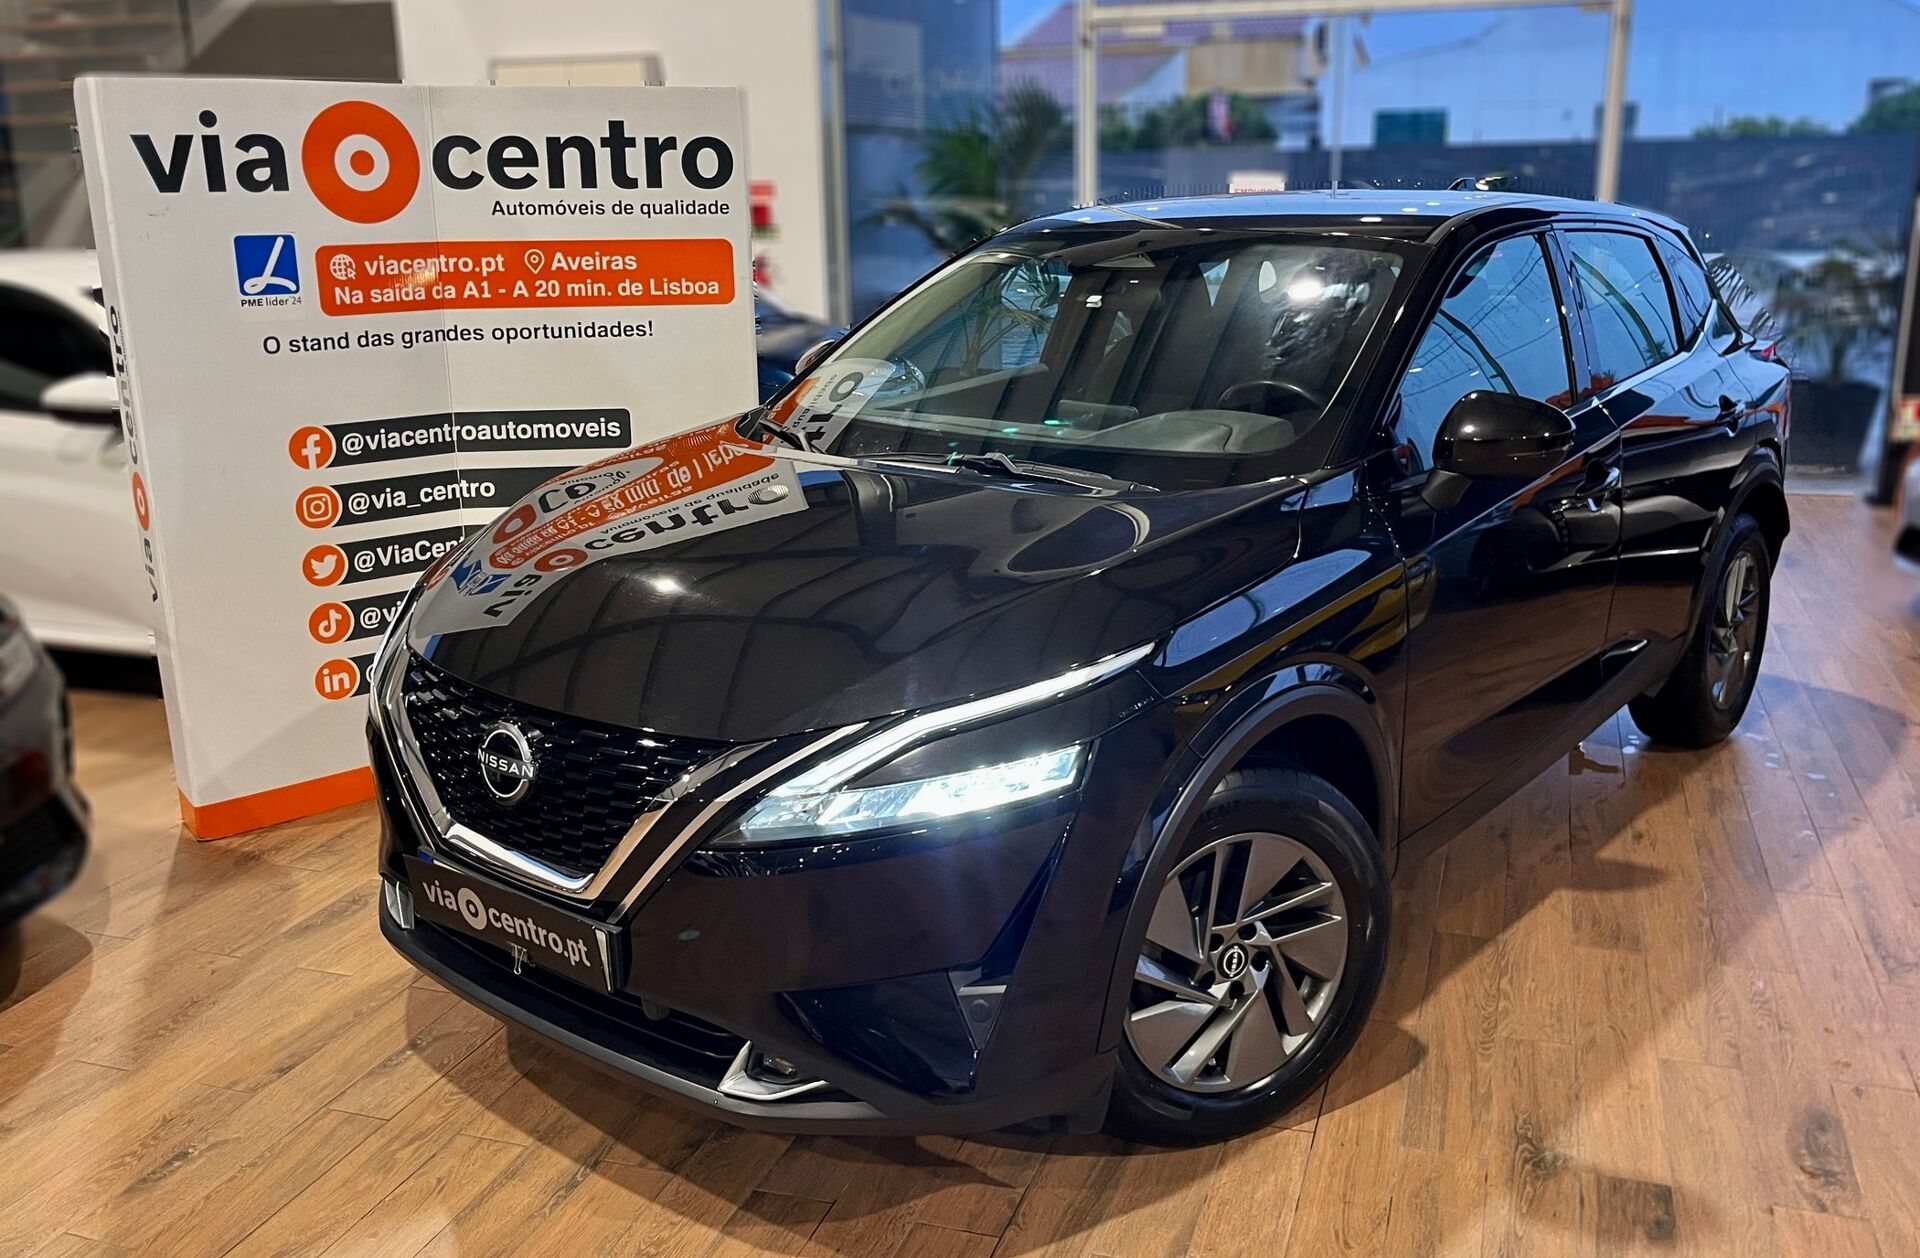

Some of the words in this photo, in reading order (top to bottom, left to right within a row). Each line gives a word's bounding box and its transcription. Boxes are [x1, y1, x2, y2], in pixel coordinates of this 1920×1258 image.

[129, 109, 290, 194] via
[432, 119, 734, 191] centro
[491, 199, 606, 217] Automóveis
[611, 199, 634, 216] de
[639, 199, 730, 219] qualidade
[364, 253, 505, 277] viacentro.pt
[551, 251, 638, 271] Aveiras
[241, 298, 264, 308] PME
[334, 286, 364, 305] Na
[370, 283, 426, 303] saída
[432, 282, 457, 299] da
[463, 280, 492, 298] A1
[512, 279, 530, 298] A
[534, 279, 560, 298] 20
[566, 278, 613, 297] min.
[617, 278, 644, 296] de
[650, 277, 720, 296] Lisboa
[262, 334, 281, 355] O
[289, 331, 350, 353] stand
[357, 330, 395, 348] das
[401, 324, 485, 349] grandes
[491, 319, 655, 344] oportunidades!
[341, 417, 621, 456] @viacentroautomoveis
[347, 479, 496, 515] @via_centro
[353, 536, 464, 572] @ViaCen
[477, 747, 535, 778] NISSAN
[422, 880, 458, 912] via
[487, 906, 592, 968] centro.pt
